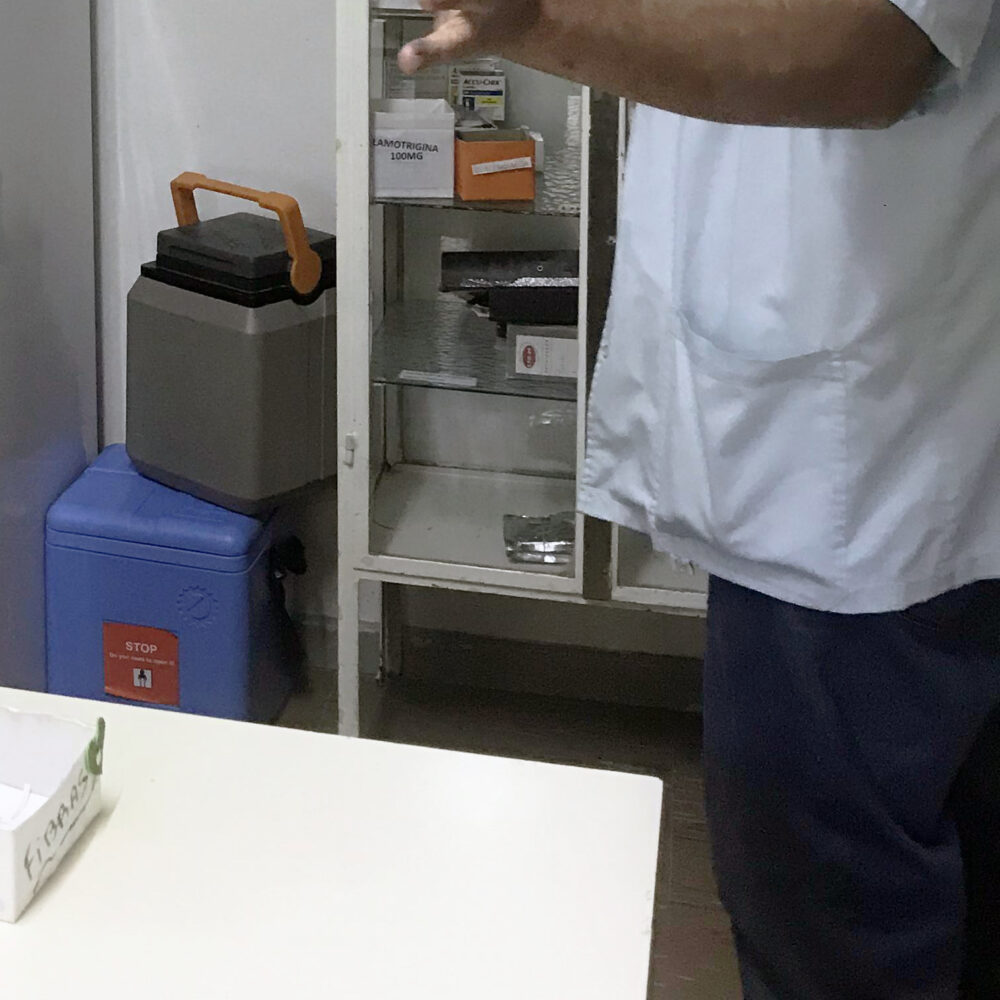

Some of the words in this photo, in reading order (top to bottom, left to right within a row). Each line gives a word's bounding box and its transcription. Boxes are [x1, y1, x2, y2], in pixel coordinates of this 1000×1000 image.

[373, 138, 439, 152] LAMOTRIGINA
[391, 151, 423, 160] 100MG
[125, 641, 158, 654] STOP
